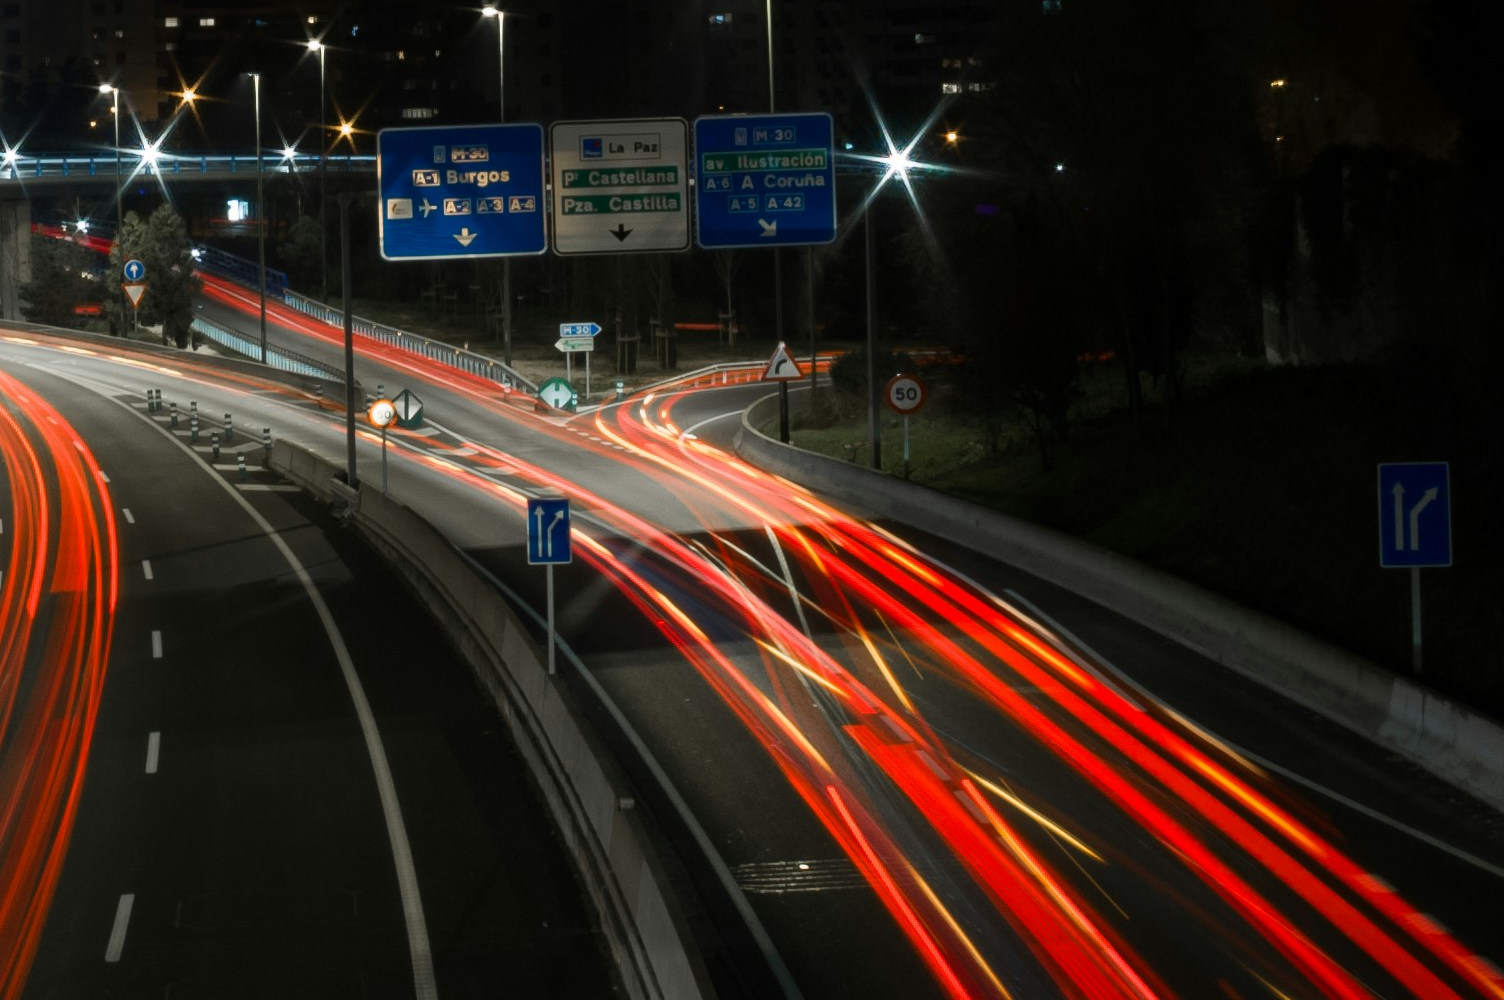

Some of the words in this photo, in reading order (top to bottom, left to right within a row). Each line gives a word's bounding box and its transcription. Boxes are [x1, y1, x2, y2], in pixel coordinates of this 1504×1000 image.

[756, 129, 794, 141] M-30
[452, 147, 487, 160] M-30
[608, 142, 625, 154] La
[633, 141, 658, 153] Paz
[737, 151, 824, 169] Ilustración
[414, 171, 439, 185] A-1
[446, 169, 510, 187] Burgos
[588, 168, 675, 185] Castellana
[706, 178, 730, 190] A-6
[741, 175, 754, 190] A
[764, 173, 826, 188] Coruña
[445, 200, 471, 214] A-2
[478, 199, 503, 213] A-3
[509, 198, 535, 211] A-4
[564, 198, 598, 213] Pza.
[608, 195, 678, 211] Castilla
[730, 198, 756, 211] A-5
[767, 196, 802, 210] A-42
[896, 387, 917, 401] 50
